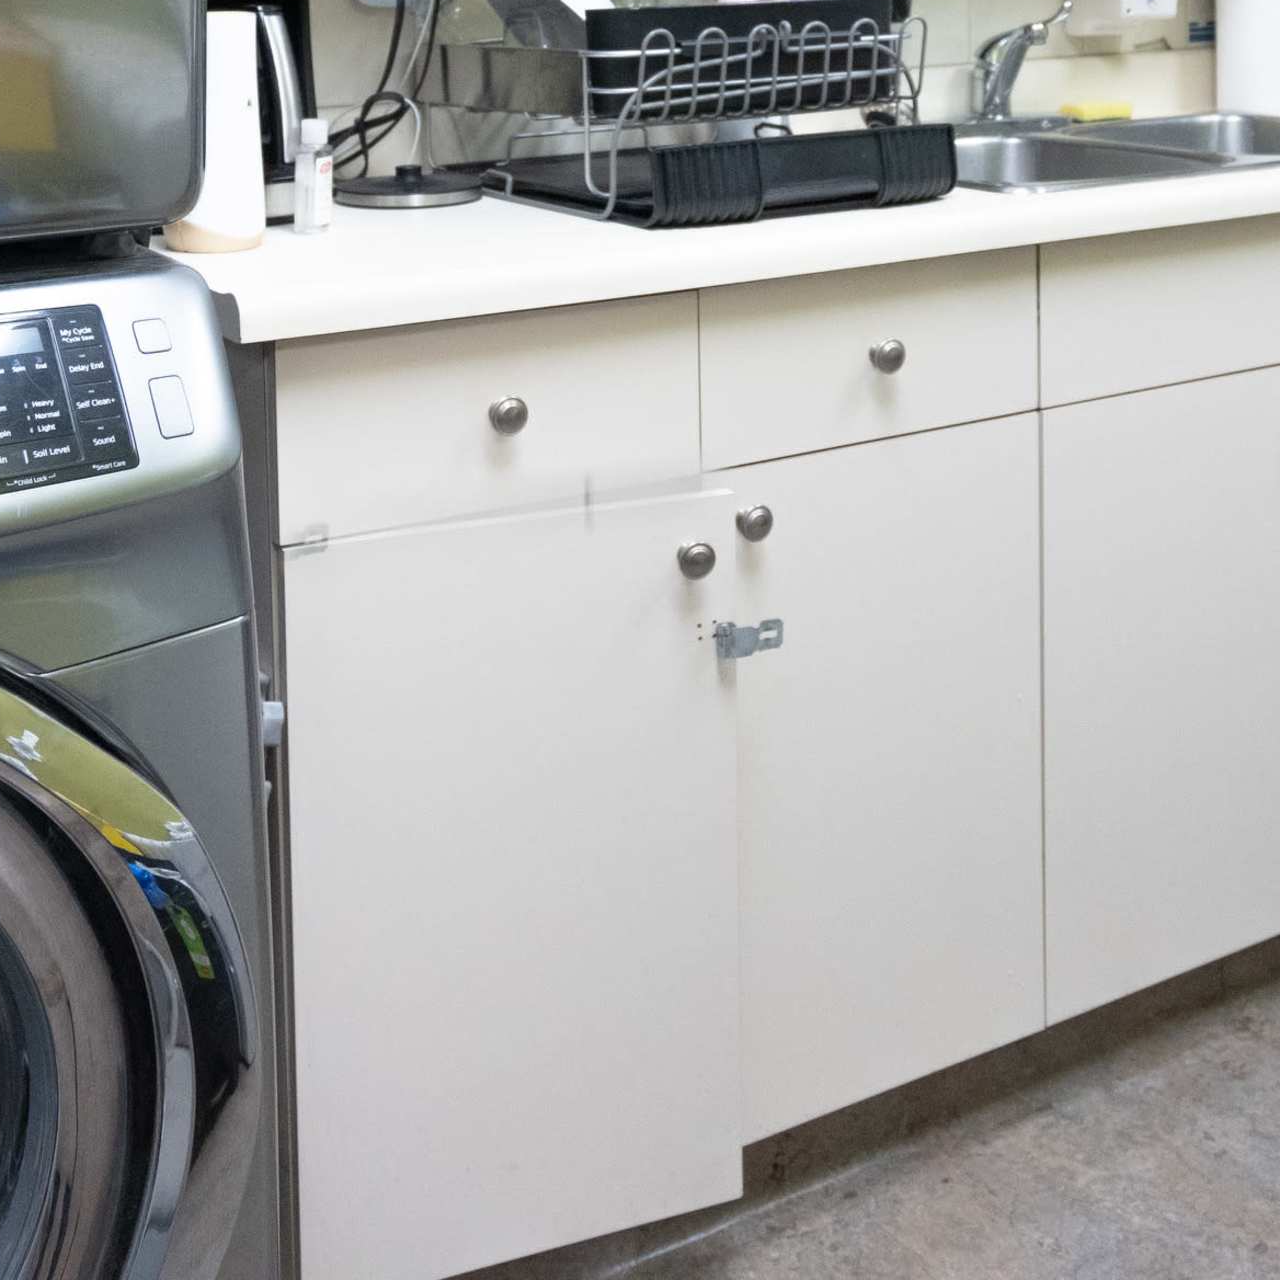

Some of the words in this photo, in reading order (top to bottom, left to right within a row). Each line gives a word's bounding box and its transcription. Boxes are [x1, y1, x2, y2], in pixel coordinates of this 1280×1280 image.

[73, 326, 93, 336] Cycle
[35, 362, 47, 370] End
[68, 363, 89, 373] Delay
[90, 361, 105, 370] End
[32, 399, 55, 409] Heavy
[76, 400, 90, 409] Self
[34, 410, 60, 420] Normal
[37, 423, 56, 433] Light
[92, 435, 116, 446] Sound
[33, 448, 48, 459] Soil
[49, 445, 71, 456] Level
[34, 475, 49, 484] Lock
